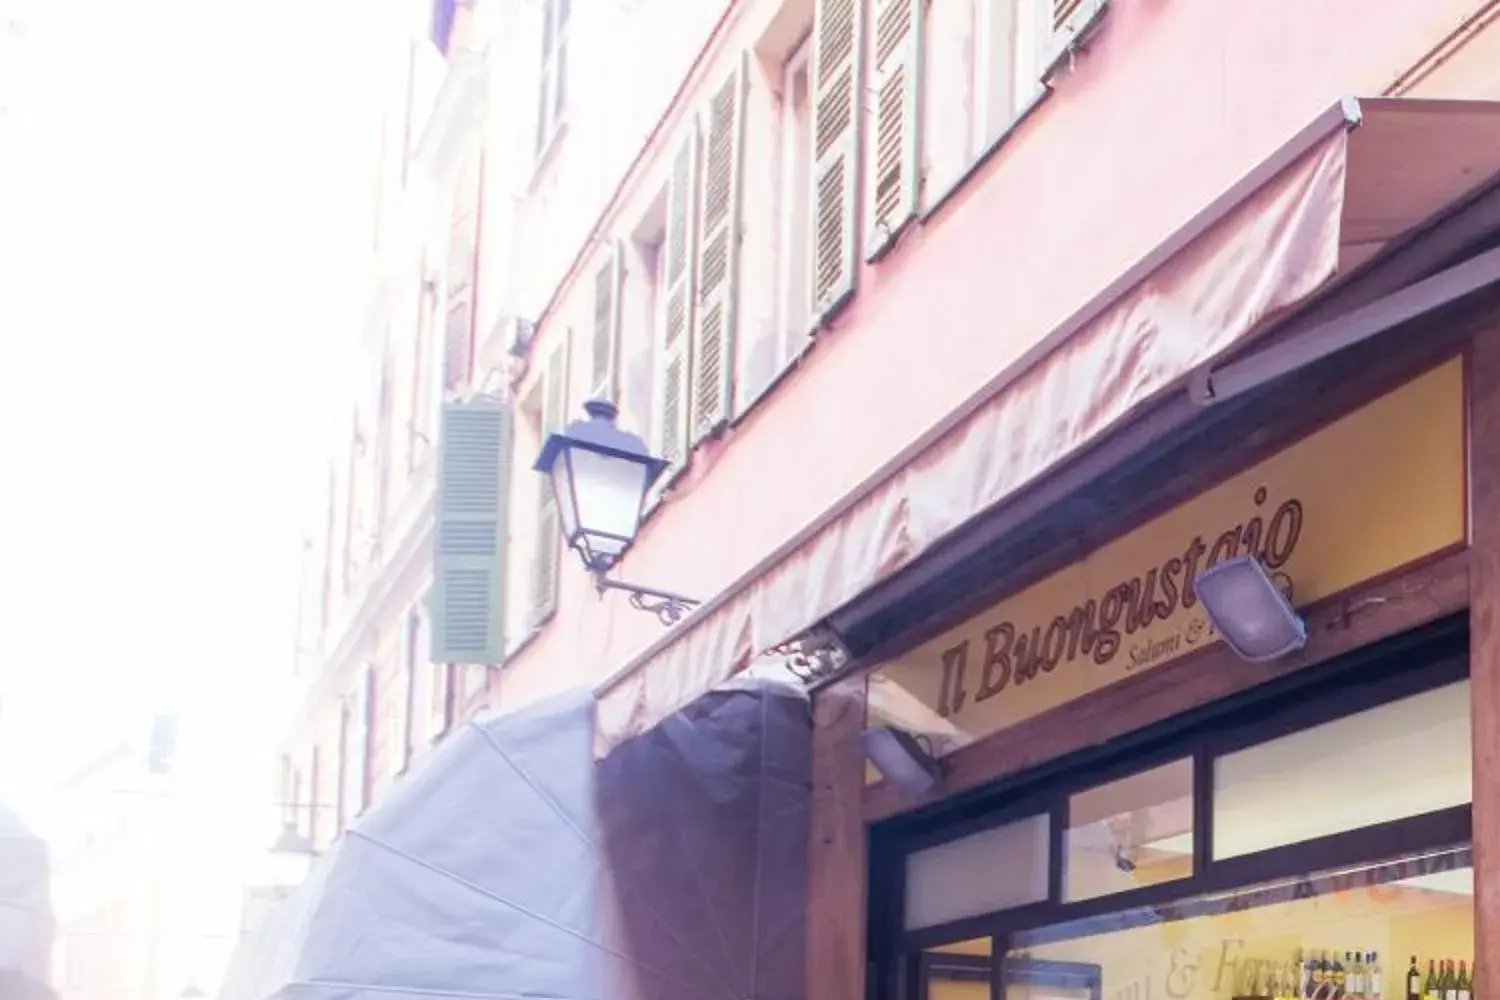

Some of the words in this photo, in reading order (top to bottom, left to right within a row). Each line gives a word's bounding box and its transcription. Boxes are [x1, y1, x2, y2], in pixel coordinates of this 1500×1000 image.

[935, 638, 971, 719] Il
[974, 486, 1303, 704] Buongustaio
[1125, 631, 1181, 670] Salumi
